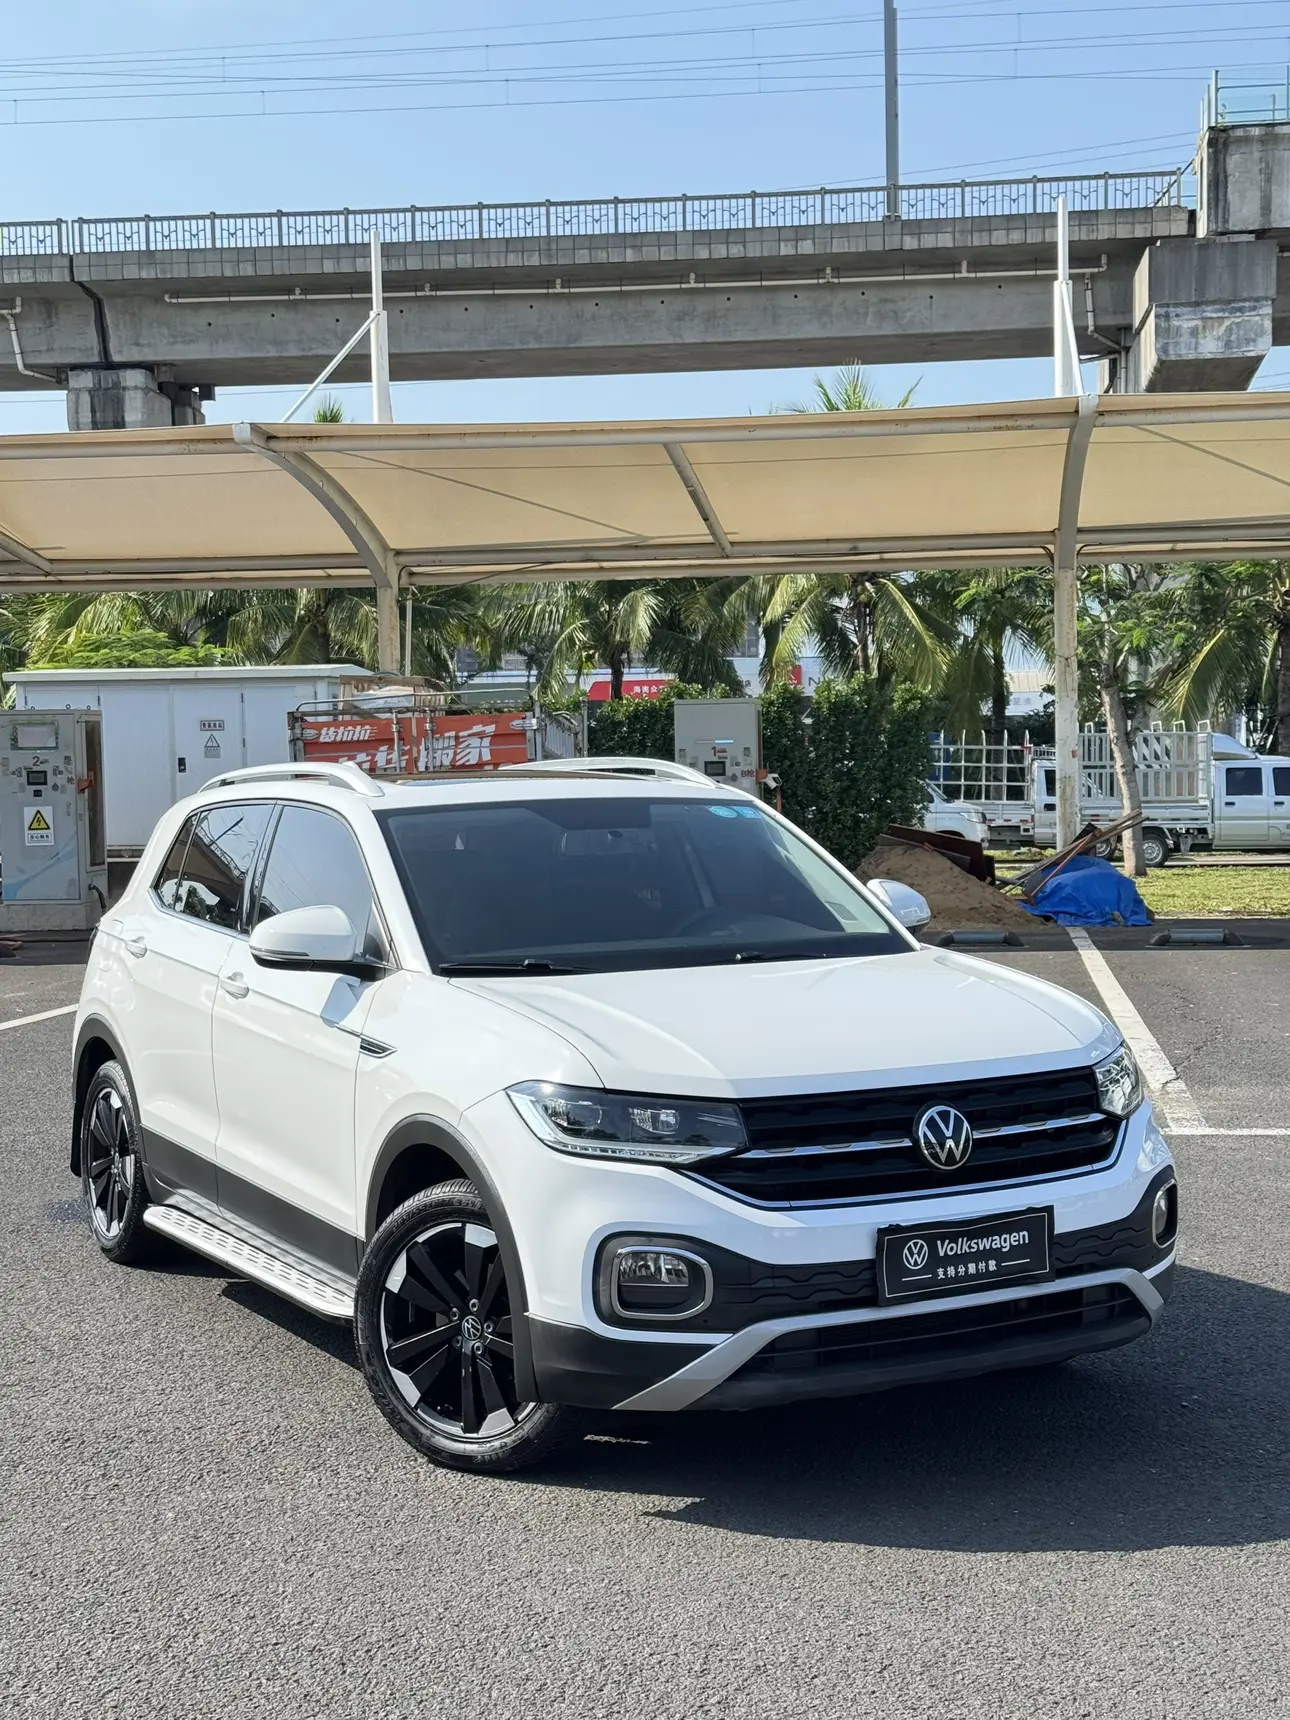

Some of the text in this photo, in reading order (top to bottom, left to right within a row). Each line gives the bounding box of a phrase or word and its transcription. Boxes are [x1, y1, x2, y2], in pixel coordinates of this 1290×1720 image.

[937, 1230, 1029, 1257] Volkswagen
[937, 1259, 998, 1280] 支持分期付款
